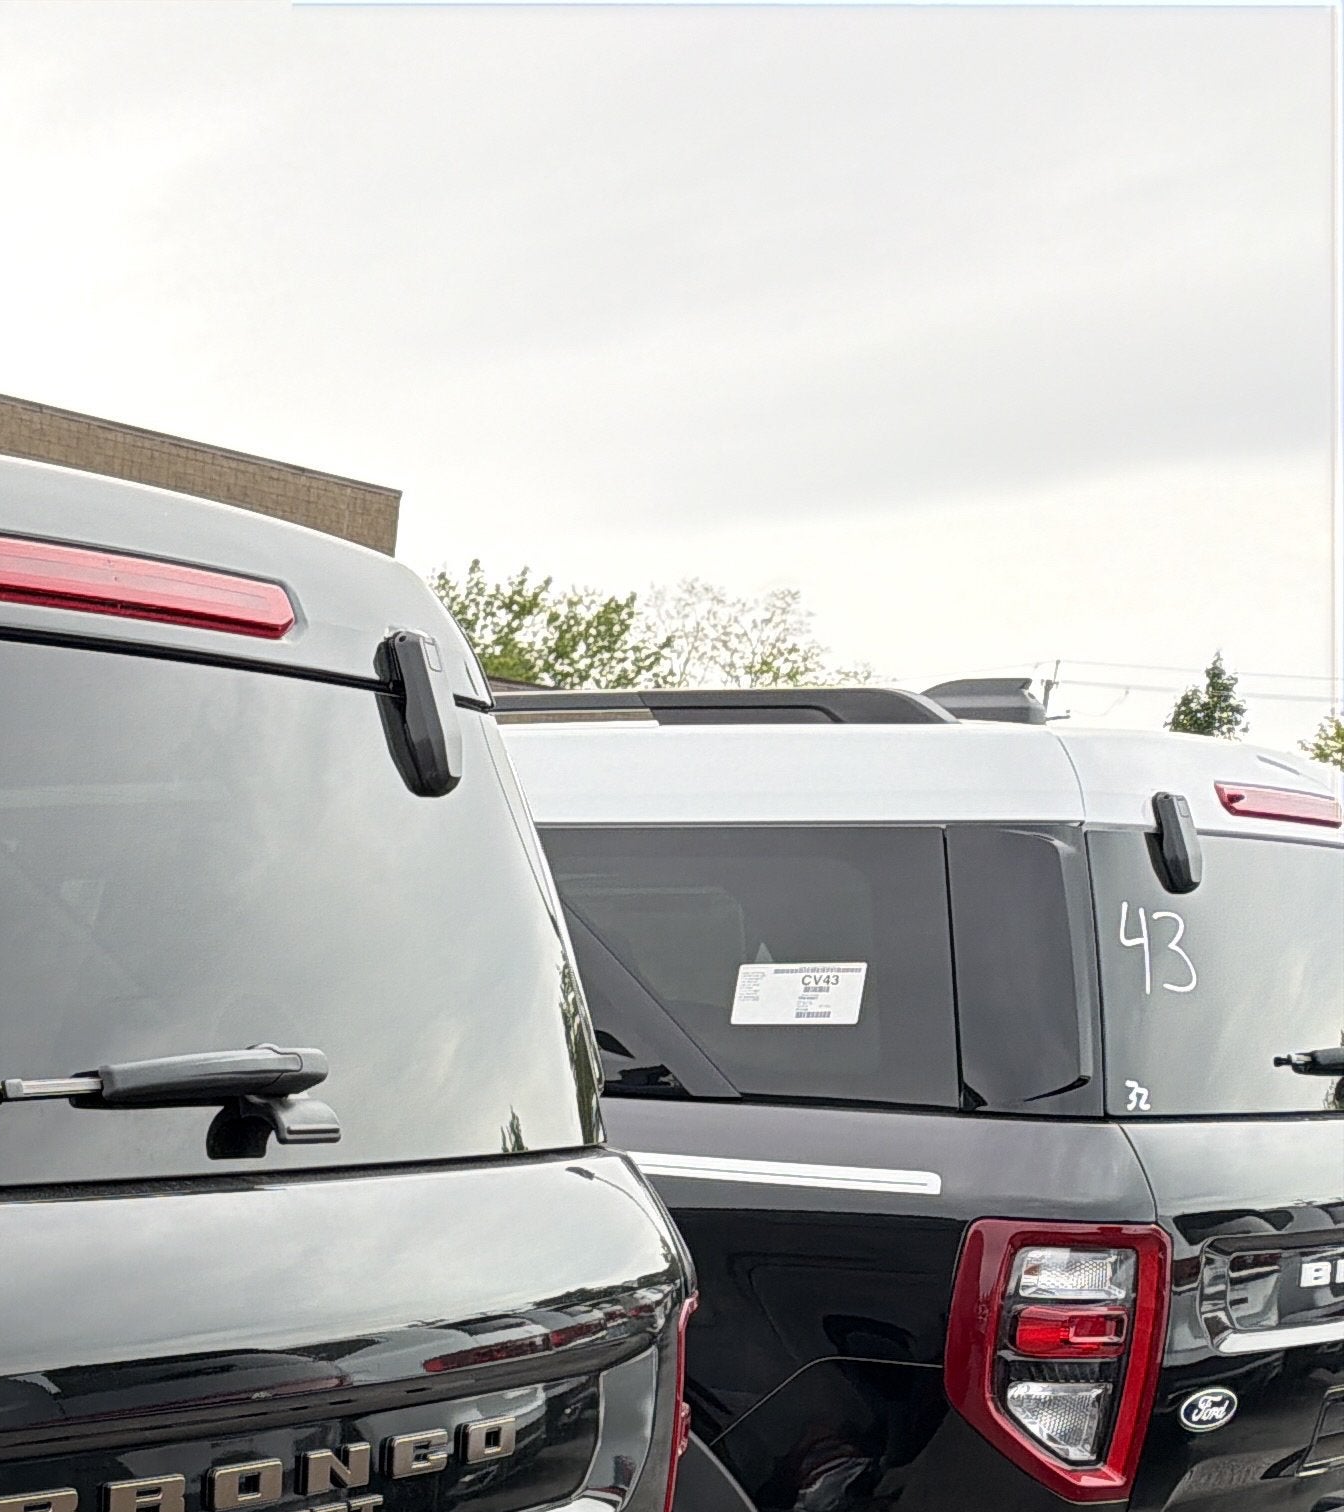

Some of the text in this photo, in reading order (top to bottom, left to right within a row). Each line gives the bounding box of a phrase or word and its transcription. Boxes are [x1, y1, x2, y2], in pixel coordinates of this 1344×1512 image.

[1119, 901, 1197, 995] 43
[801, 974, 840, 986] CV43
[1191, 1395, 1230, 1422] Ford
